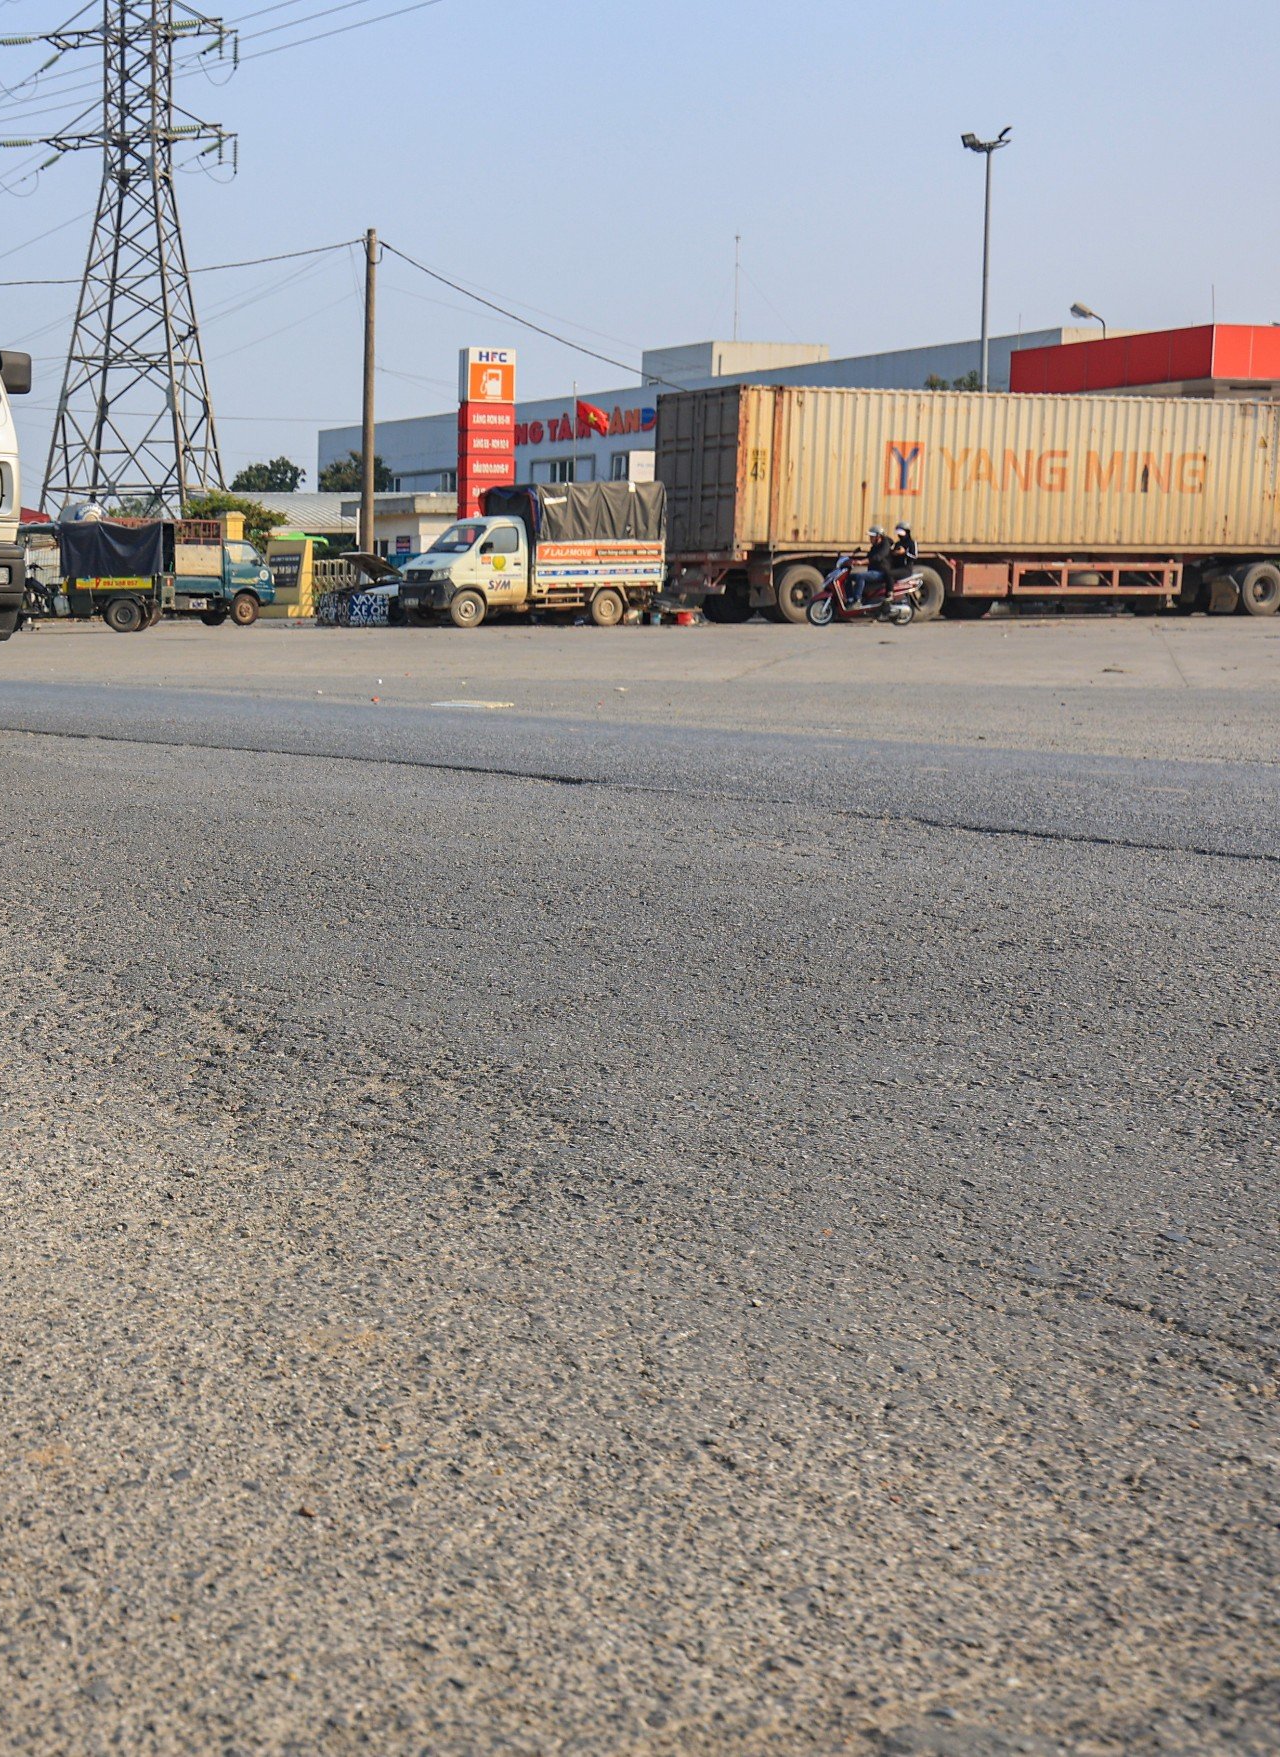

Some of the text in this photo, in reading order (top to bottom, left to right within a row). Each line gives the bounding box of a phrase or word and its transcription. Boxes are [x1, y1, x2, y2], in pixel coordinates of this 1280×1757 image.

[478, 351, 507, 362] HFC
[750, 462, 766, 481] 45
[938, 447, 1068, 492] YANG
[1084, 449, 1207, 494] MING
[550, 548, 593, 557] LALAMOVE
[487, 580, 511, 592] SYM
